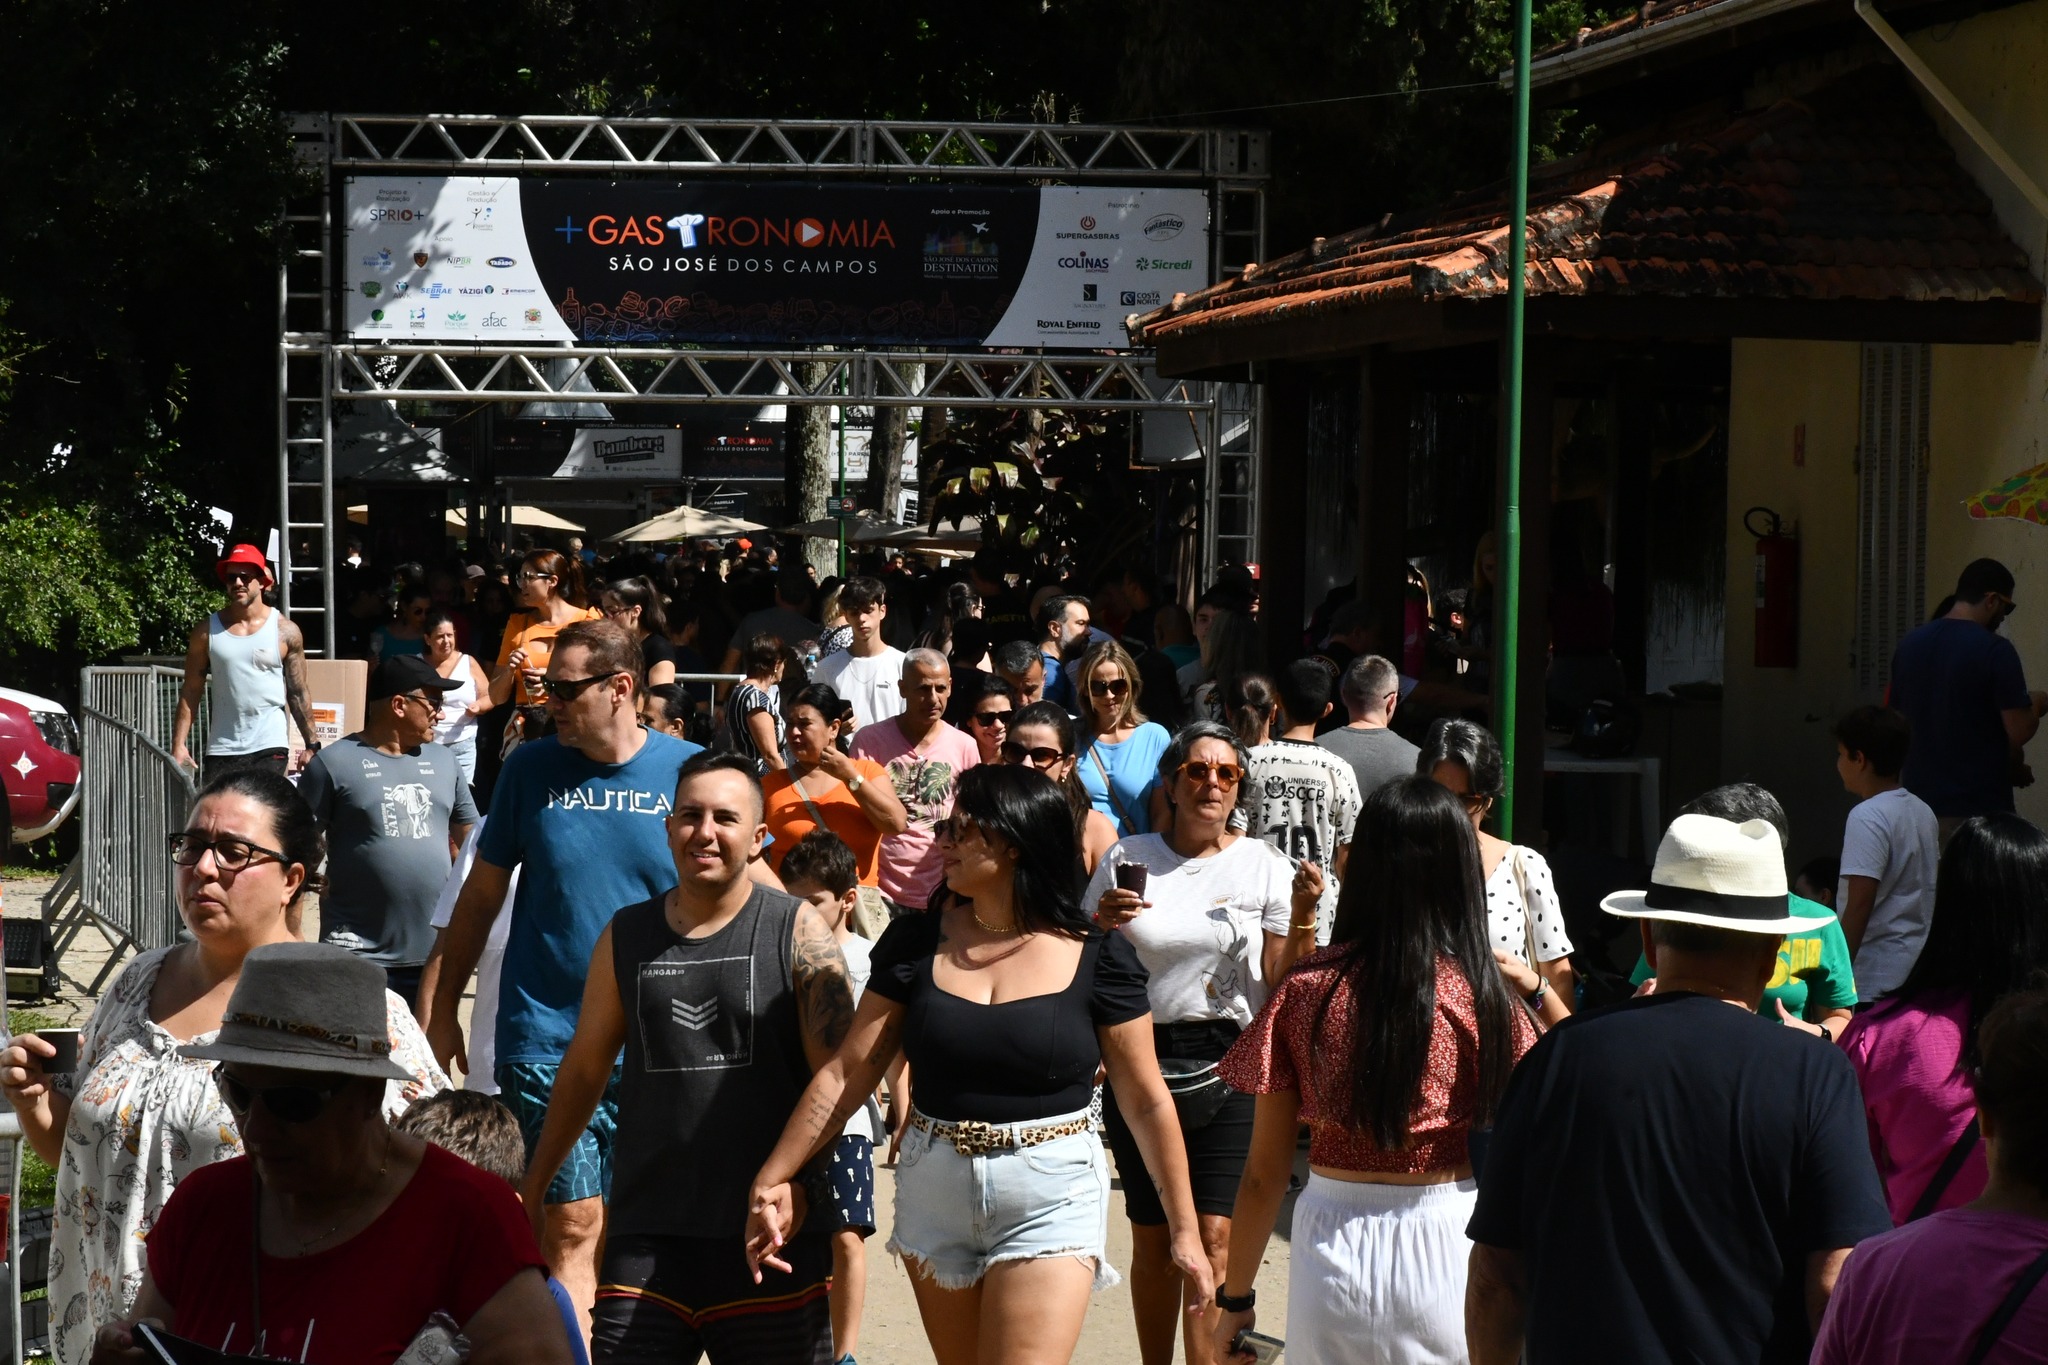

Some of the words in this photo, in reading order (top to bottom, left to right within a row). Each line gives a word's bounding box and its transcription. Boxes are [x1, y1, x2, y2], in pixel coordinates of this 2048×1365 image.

[1056, 232, 1120, 240] SUPERGASBRAS
[609, 253, 653, 271] SÃO
[663, 254, 717, 272] JOSÉ
[727, 258, 774, 272] DOS
[783, 259, 877, 274] CAMPOS
[1058, 253, 1109, 269] COLINAS
[1151, 259, 1193, 270] Sicredi
[924, 263, 998, 273] DESTINATION
[420, 287, 453, 295] SEBRAE
[459, 286, 484, 295] YÁZIGI
[482, 312, 508, 328] afac
[1037, 319, 1065, 329] ROYAL
[1066, 320, 1101, 329] ENFIELD
[595, 436, 664, 457] Bamberg
[1287, 785, 1326, 802] SCCP
[548, 787, 672, 815] NAUTICA
[383, 785, 400, 838] SAFARI
[642, 968, 677, 977] HANGAR
